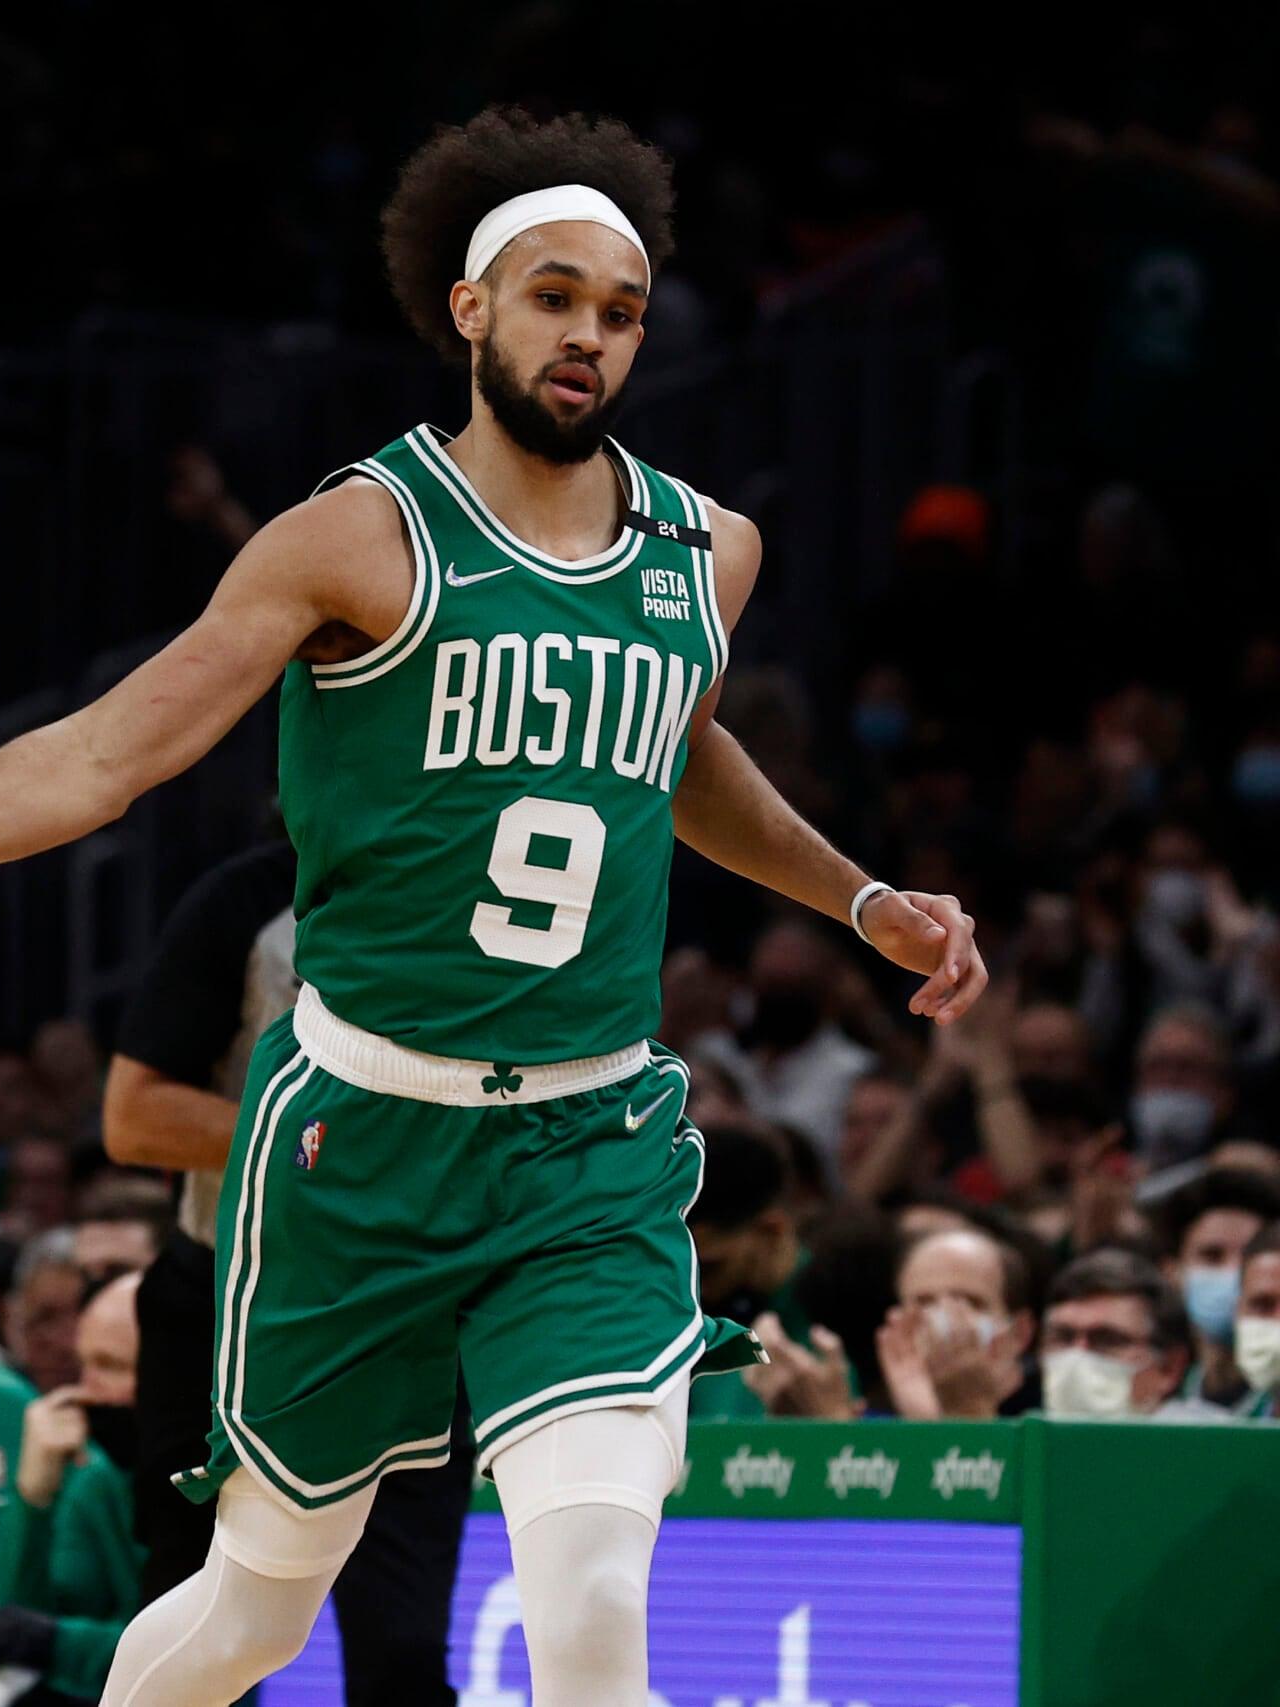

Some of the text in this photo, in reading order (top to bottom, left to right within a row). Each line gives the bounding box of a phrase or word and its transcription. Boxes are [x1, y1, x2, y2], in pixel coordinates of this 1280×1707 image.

[657, 520, 679, 539] 24
[640, 568, 690, 600] VISTA
[643, 597, 691, 621] PRINT
[423, 632, 703, 793] BOSTON
[469, 796, 607, 969] 9
